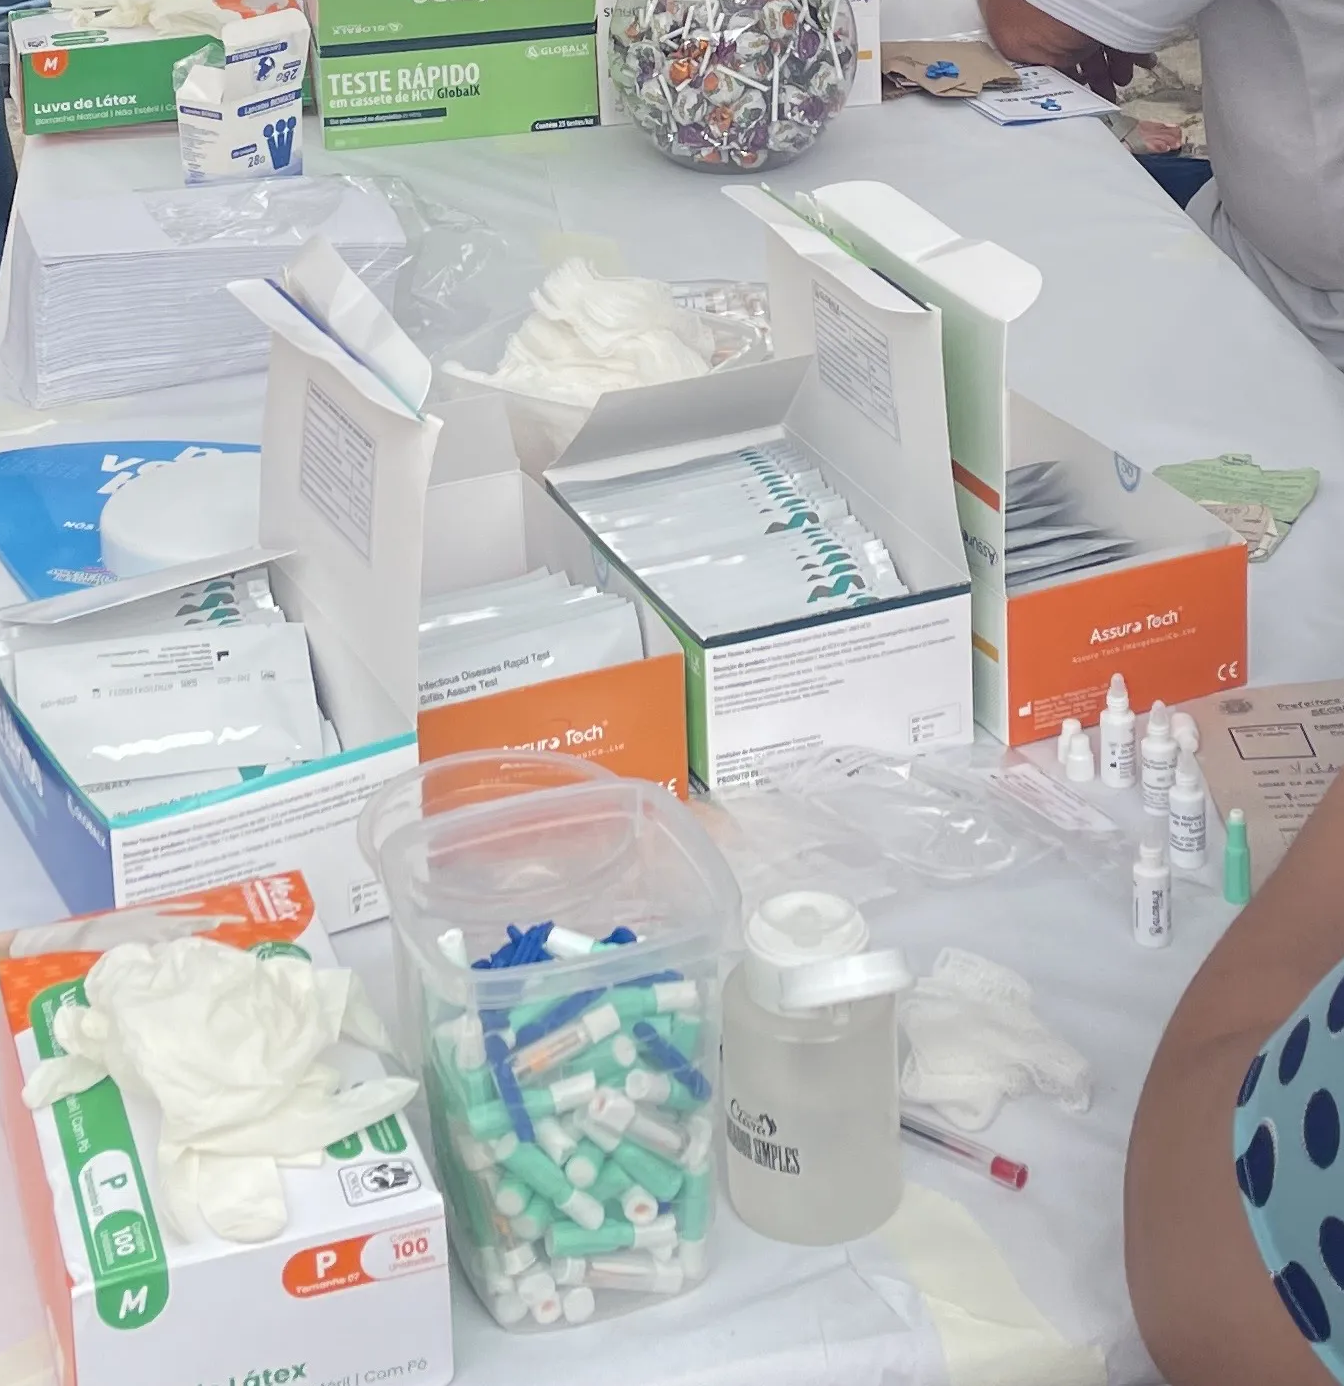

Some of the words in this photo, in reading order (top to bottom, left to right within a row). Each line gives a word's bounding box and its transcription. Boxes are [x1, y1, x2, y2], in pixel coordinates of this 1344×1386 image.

[540, 43, 589, 56] GLOBALX
[43, 56, 59, 73] M
[327, 70, 392, 96] TESTE
[397, 62, 481, 91] RÁPIDO
[34, 102, 71, 115] Luva
[73, 97, 93, 110] de
[96, 94, 138, 108] Látex
[329, 98, 348, 109] em
[349, 95, 393, 108] cassete
[394, 92, 409, 104] de
[411, 89, 435, 102] HCV
[437, 84, 481, 99] GlobalX
[418, 674, 460, 693] Infectious
[461, 664, 502, 682] Diseases
[503, 655, 530, 670] Rapid
[531, 649, 552, 664] Test
[446, 683, 478, 699] Assure
[479, 677, 499, 691] Test
[100, 1171, 129, 1191] P
[111, 1226, 136, 1257] 100
[388, 1226, 431, 1244] Contém
[392, 1236, 429, 1261] 100
[315, 1249, 338, 1279] P
[295, 1277, 345, 1294] Tamanho
[118, 1285, 149, 1320] M
[364, 1365, 405, 1383] Com
[407, 1357, 428, 1374] Pó
